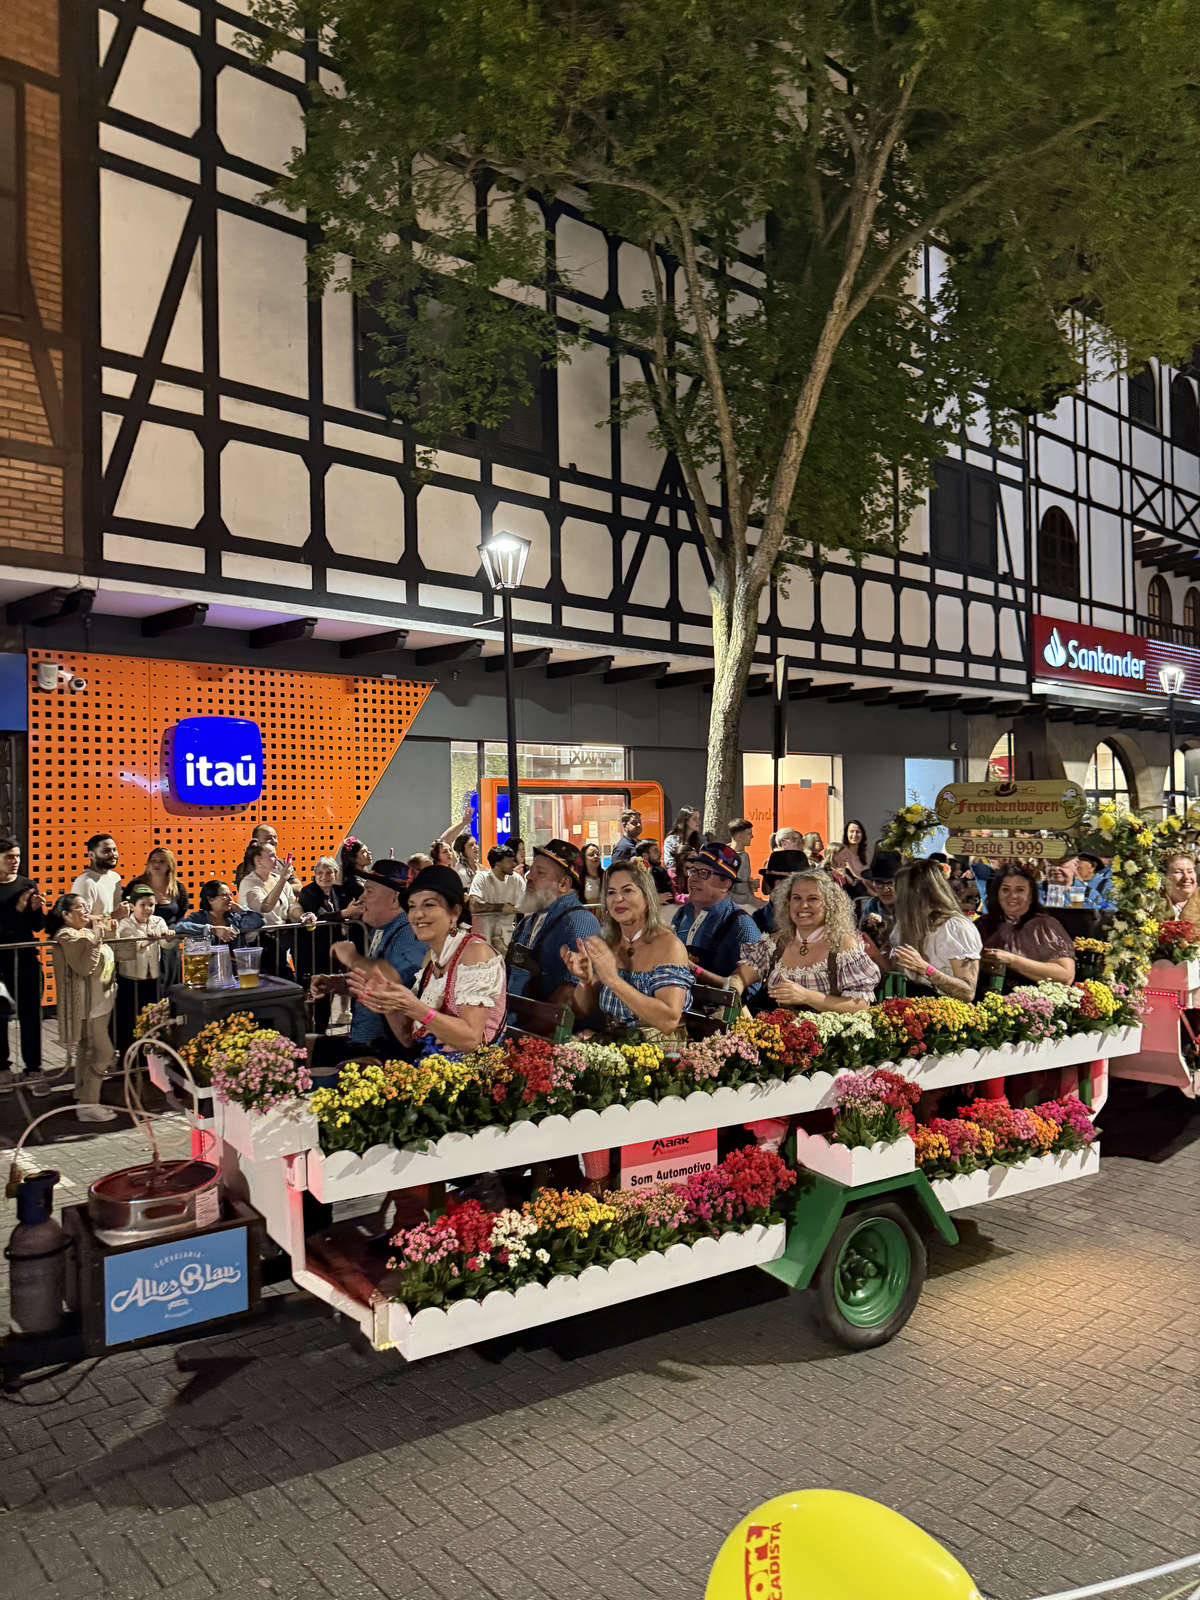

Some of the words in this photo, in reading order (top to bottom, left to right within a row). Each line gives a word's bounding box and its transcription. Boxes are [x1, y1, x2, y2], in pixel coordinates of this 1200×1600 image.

[1068, 639, 1146, 680] Santander
[185, 752, 256, 787] itaú
[961, 838, 1005, 854] Desde
[1009, 839, 1044, 856] 1999
[630, 1174, 654, 1187] Som
[656, 1161, 711, 1181] Automotivo
[110, 1277, 183, 1313] Alles
